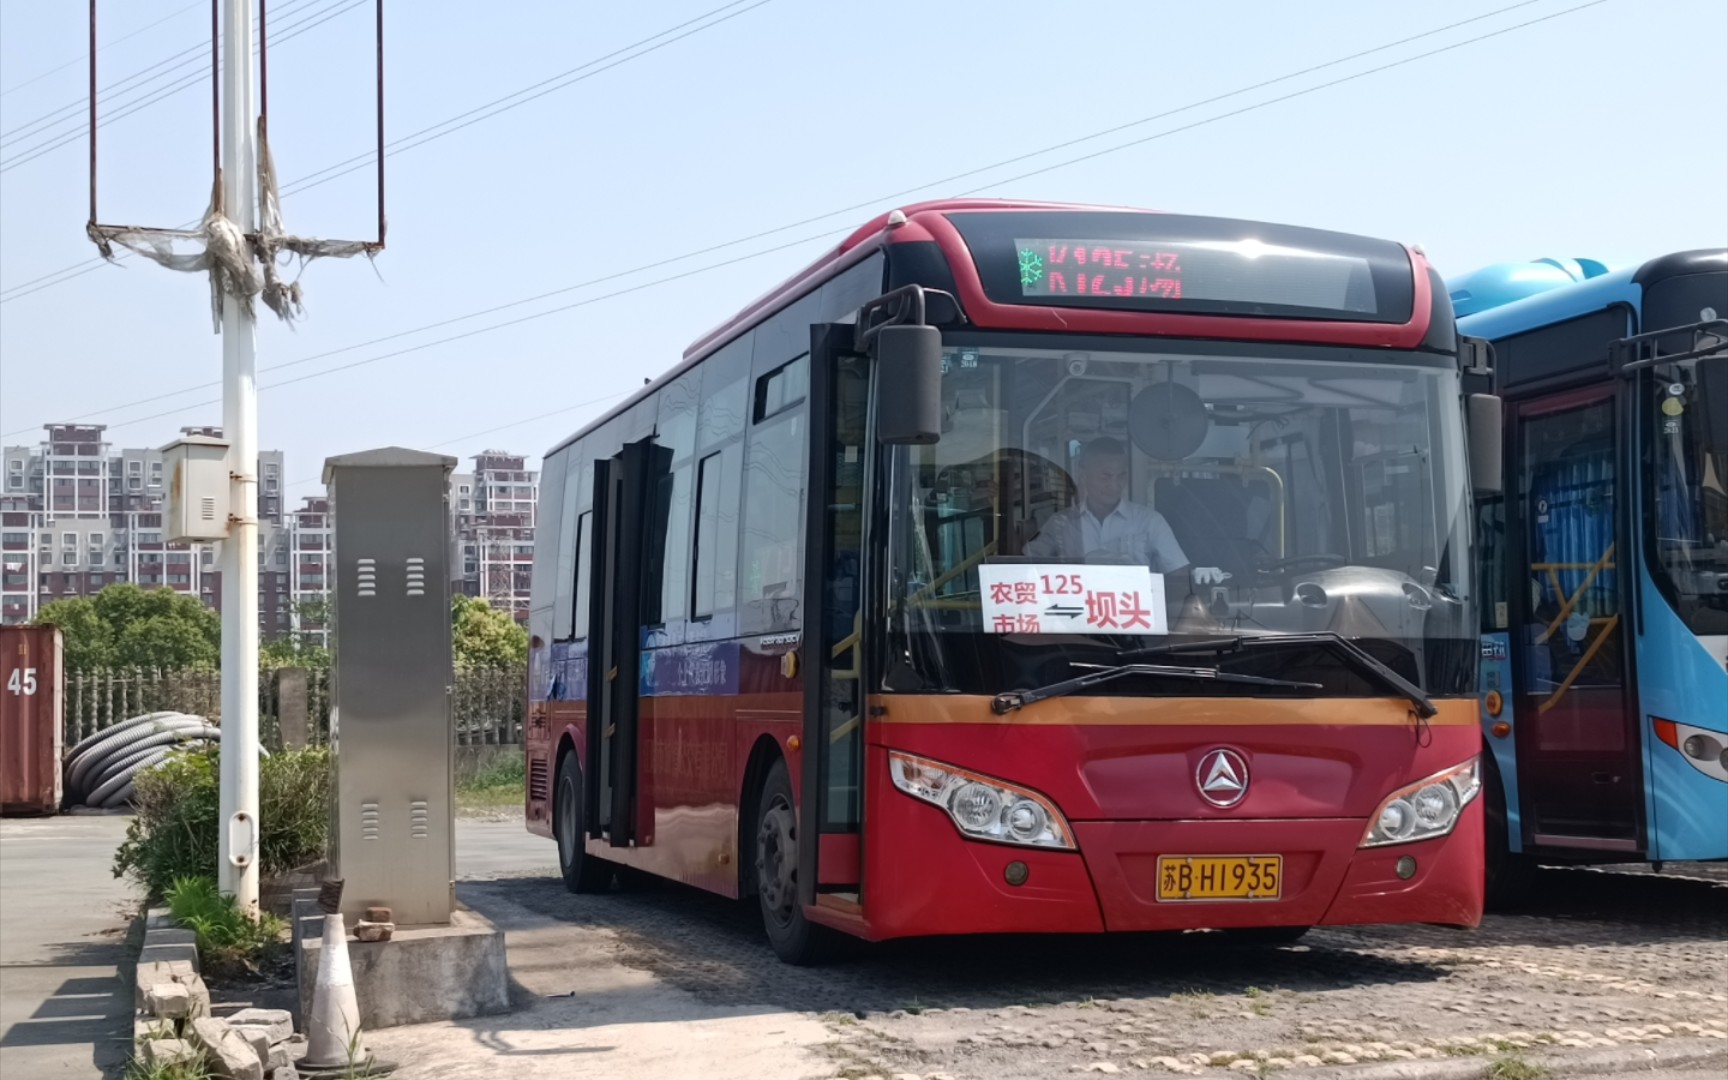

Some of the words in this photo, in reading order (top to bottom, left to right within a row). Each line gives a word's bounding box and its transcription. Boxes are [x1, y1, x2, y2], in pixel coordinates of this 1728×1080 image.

[990, 582, 1038, 605] 农贸
[1040, 574, 1083, 595] 125
[1085, 590, 1151, 629] 坝头
[992, 613, 1040, 634] 市场
[7, 667, 37, 696] 45
